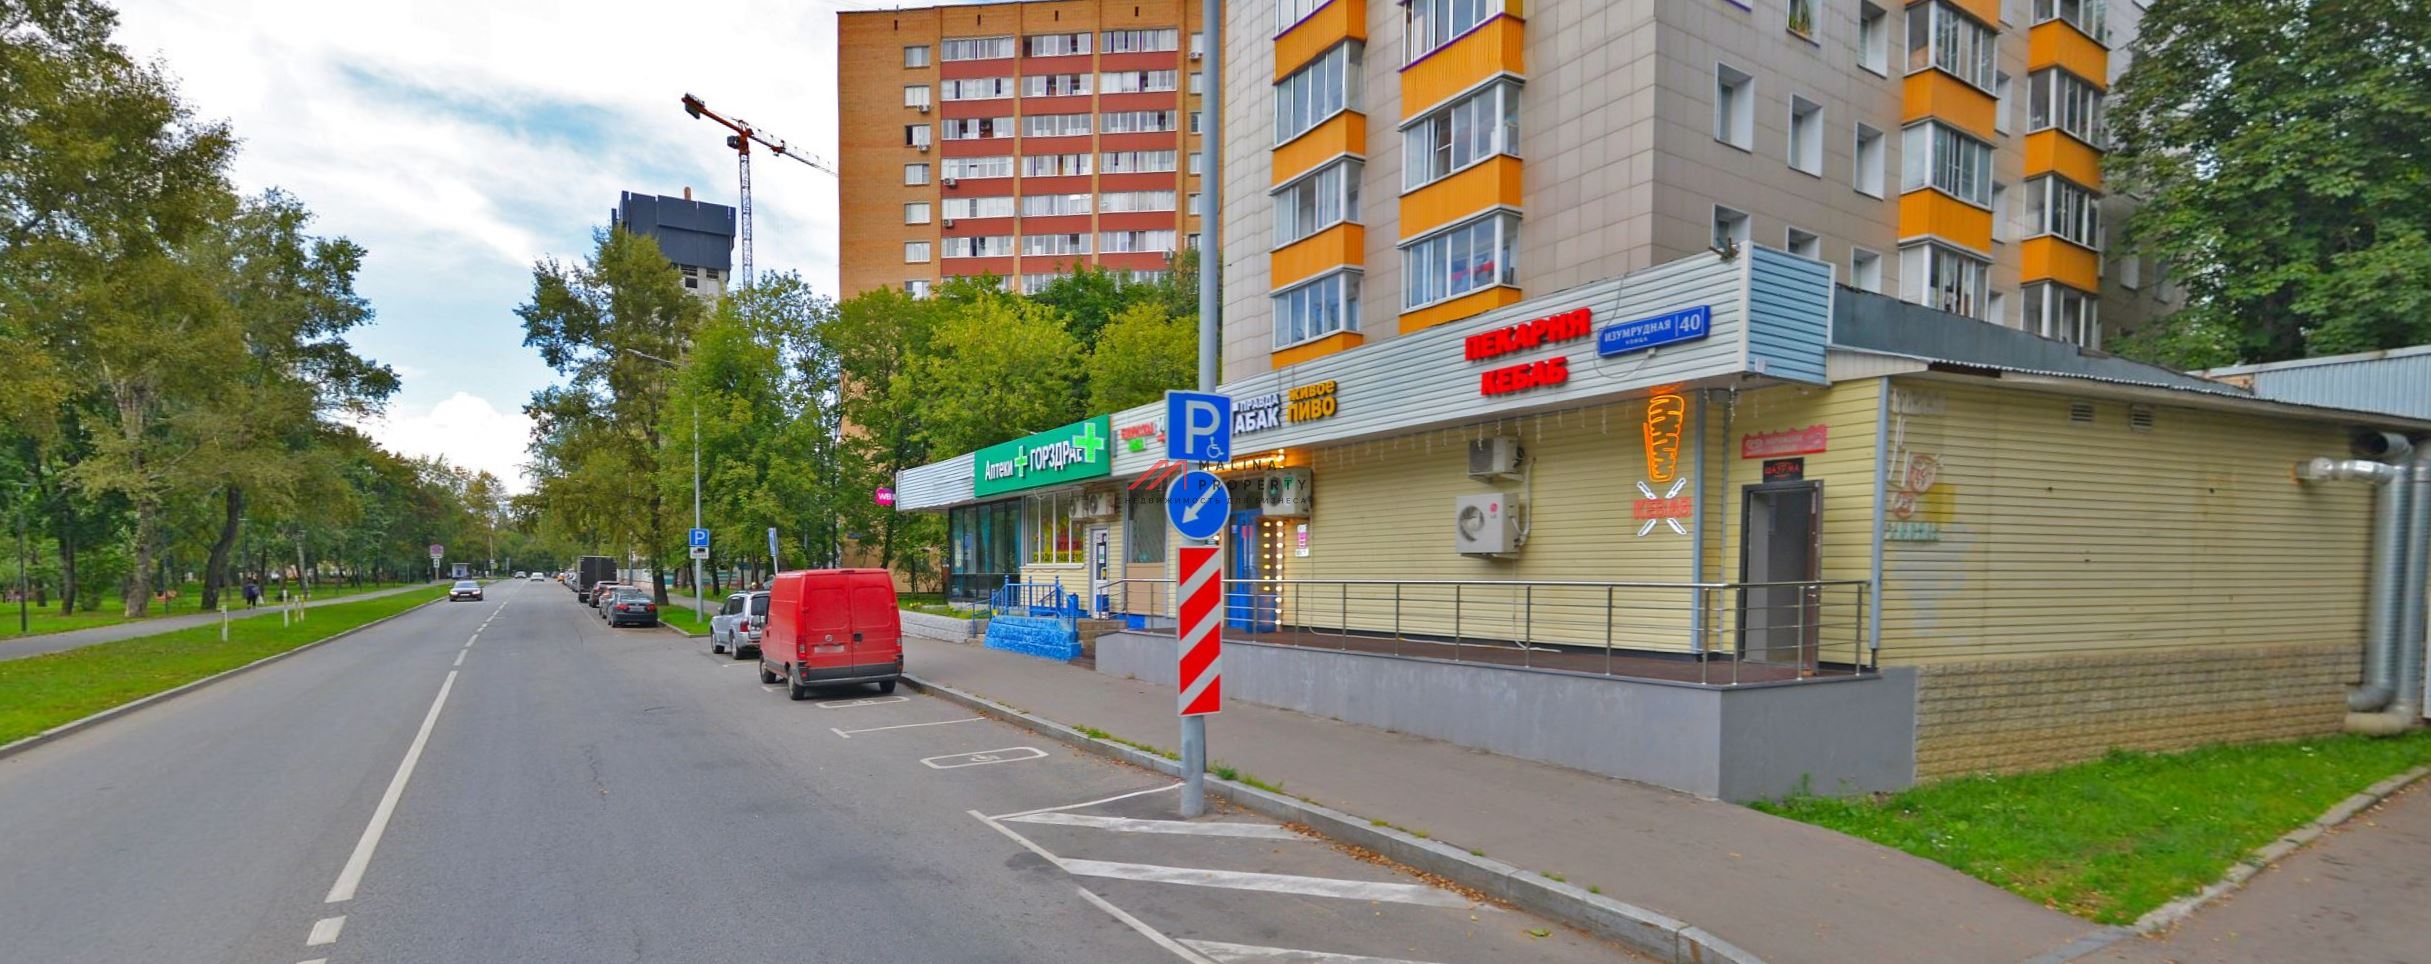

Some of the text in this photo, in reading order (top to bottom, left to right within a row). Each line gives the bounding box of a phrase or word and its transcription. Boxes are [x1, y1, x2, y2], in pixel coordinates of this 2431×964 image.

[1464, 306, 1593, 362] ПЕКАРНЯ
[1604, 313, 1701, 343] ИЗУМРУДНАЯ 40
[1480, 356, 1569, 396] КЕБАБ
[1239, 393, 1280, 412] ПРАВДА
[1286, 396, 1337, 424] ПИВО
[1185, 400, 1221, 454] P
[1232, 404, 1281, 434] АБАК
[985, 459, 1013, 481] Аптеки
[877, 492, 892, 501] WB
[694, 531, 706, 545] P
